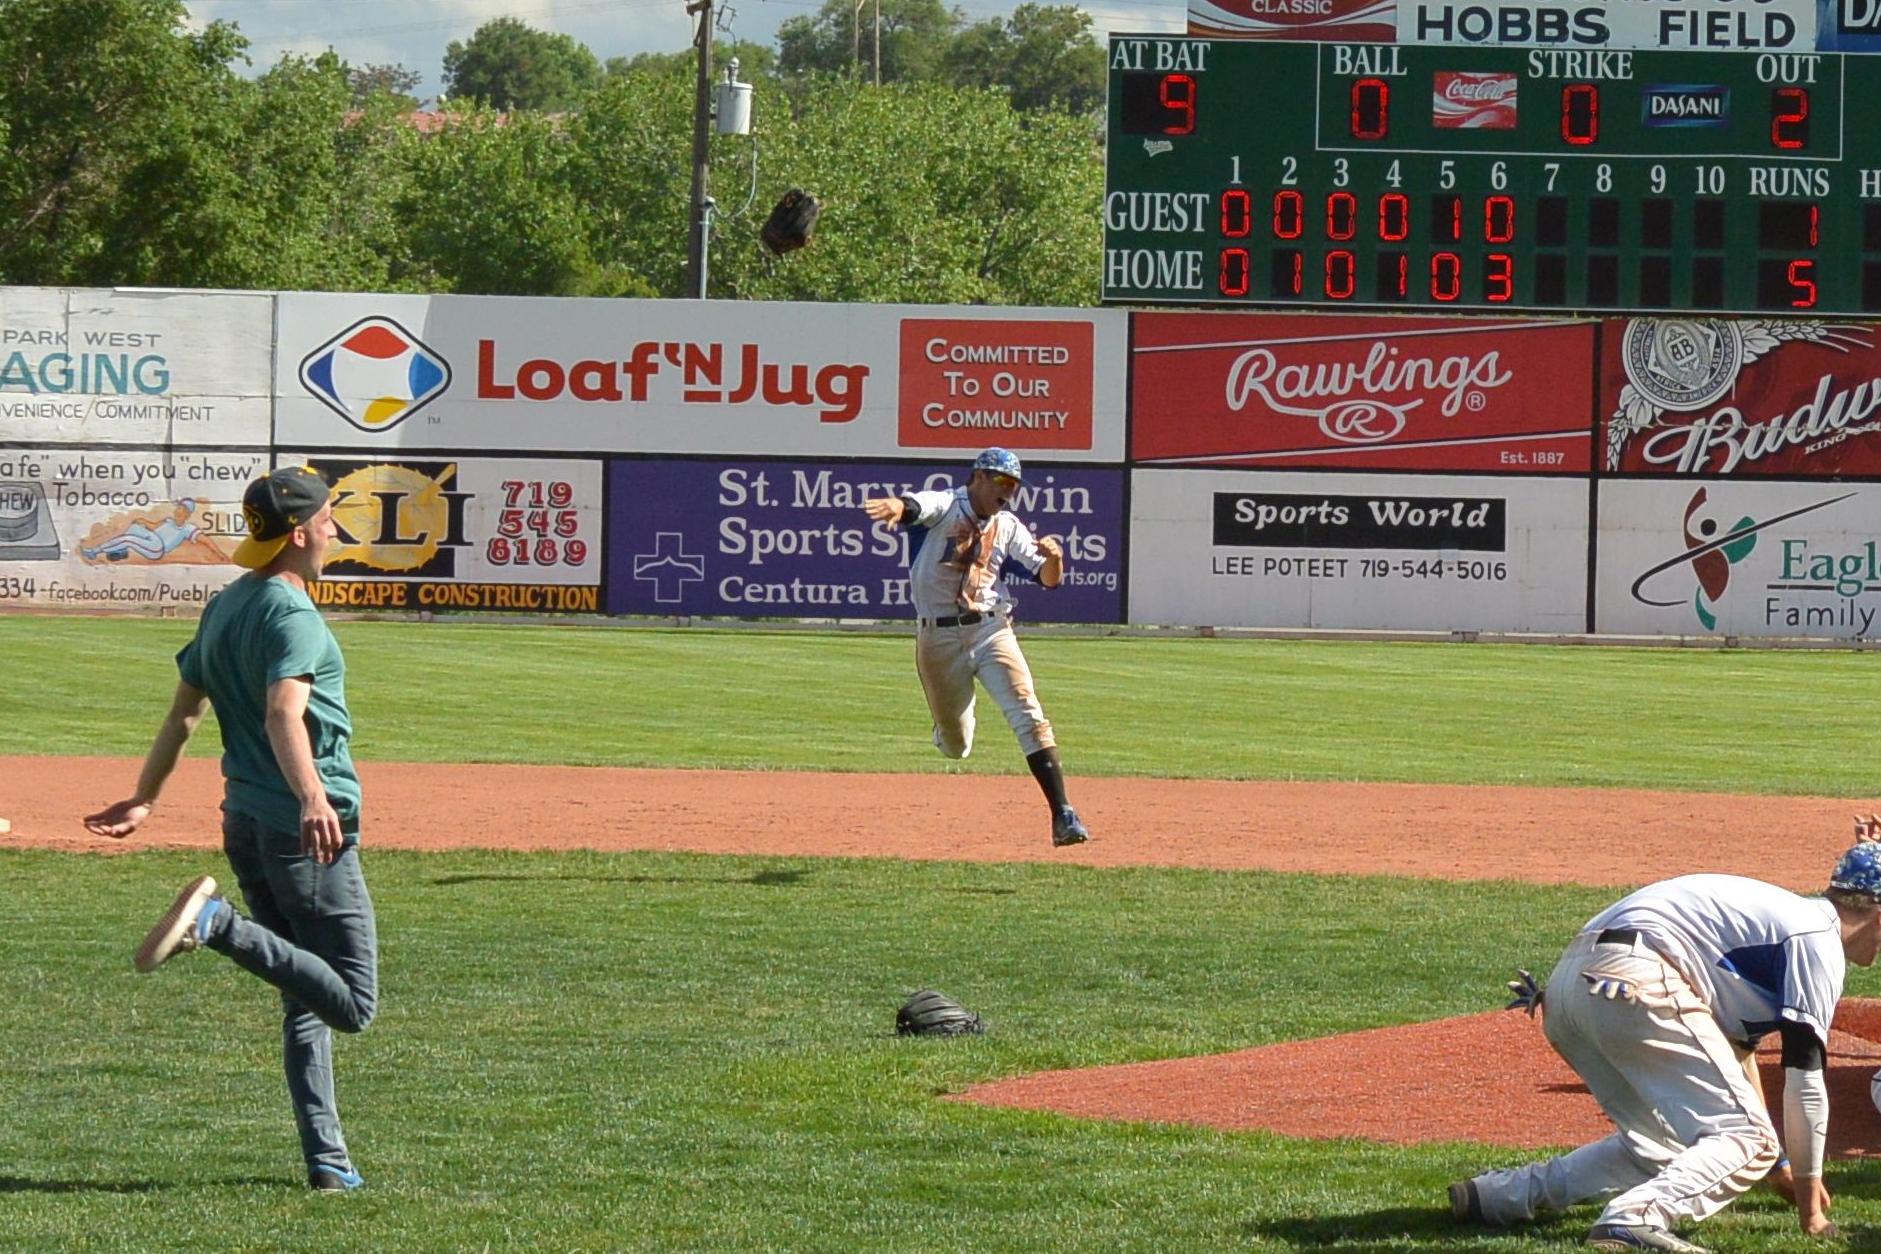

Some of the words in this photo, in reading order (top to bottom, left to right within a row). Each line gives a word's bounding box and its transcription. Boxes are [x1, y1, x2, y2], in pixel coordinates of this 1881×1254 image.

[1252, 0, 1332, 14] CLASSIC
[1417, 5, 1610, 44] HOBBS
[1659, 10, 1796, 47] FIELD
[1111, 43, 1149, 71] AT
[1156, 43, 1211, 72] BAT
[1333, 46, 1408, 76] BALL
[1528, 51, 1633, 80] STRIKE
[1757, 55, 1820, 84] OUT
[1159, 74, 1197, 135] 9
[1351, 77, 1389, 140] 0
[1561, 83, 1598, 145] 0
[1652, 92, 1720, 117] DASANI
[1771, 87, 1808, 149] 2
[1230, 156, 1242, 185] 1
[1282, 157, 1298, 186] 2
[1333, 158, 1349, 187] 3
[1386, 159, 1402, 188] 4
[1440, 161, 1455, 190] 5
[1491, 161, 1507, 190] 6
[1544, 163, 1560, 192] 7
[1596, 164, 1612, 193] 8
[1650, 165, 1667, 194] 9
[1695, 165, 1725, 195] 10
[1749, 168, 1830, 197] RUNS
[1105, 192, 1210, 232] GUEST
[1221, 189, 1250, 238] 0
[1273, 190, 1303, 239] 0
[1327, 191, 1356, 240] 0
[1379, 192, 1408, 241] 0
[1484, 194, 1513, 243] 0
[1107, 250, 1204, 290] HOME
[1220, 247, 1249, 296] 0
[1325, 250, 1354, 298] 0
[1431, 252, 1460, 300] 0
[1487, 254, 1513, 301] 3
[1788, 260, 1816, 307] 5
[3, 330, 68, 346] PARK
[84, 331, 163, 348] WEST
[925, 338, 1069, 364] COMMITTED
[477, 339, 659, 402] Loaf
[728, 343, 870, 423] Jug
[992, 372, 1050, 397] OUR
[1226, 342, 1512, 417] Rawlings
[922, 402, 1069, 429] COMMUNITY
[59, 456, 124, 479] when
[134, 462, 176, 485] you
[1501, 451, 1528, 465] Est.
[1532, 451, 1565, 465] 1887
[53, 482, 150, 507] Tobacco
[502, 481, 572, 508] 719
[719, 469, 778, 507] St.
[498, 510, 578, 538] 545
[1234, 499, 1349, 530] Sports
[1369, 501, 1490, 528] World
[487, 537, 587, 566] 8189
[719, 516, 864, 565] Sports
[1212, 557, 1254, 576] LEE
[1264, 558, 1348, 578] POTEET
[1359, 559, 1507, 581] 719-544-5016
[307, 581, 407, 607] NDSCAPE
[418, 583, 599, 610] CONSTRUCTION
[718, 576, 869, 604] Centura
[1766, 598, 1875, 641] Family
